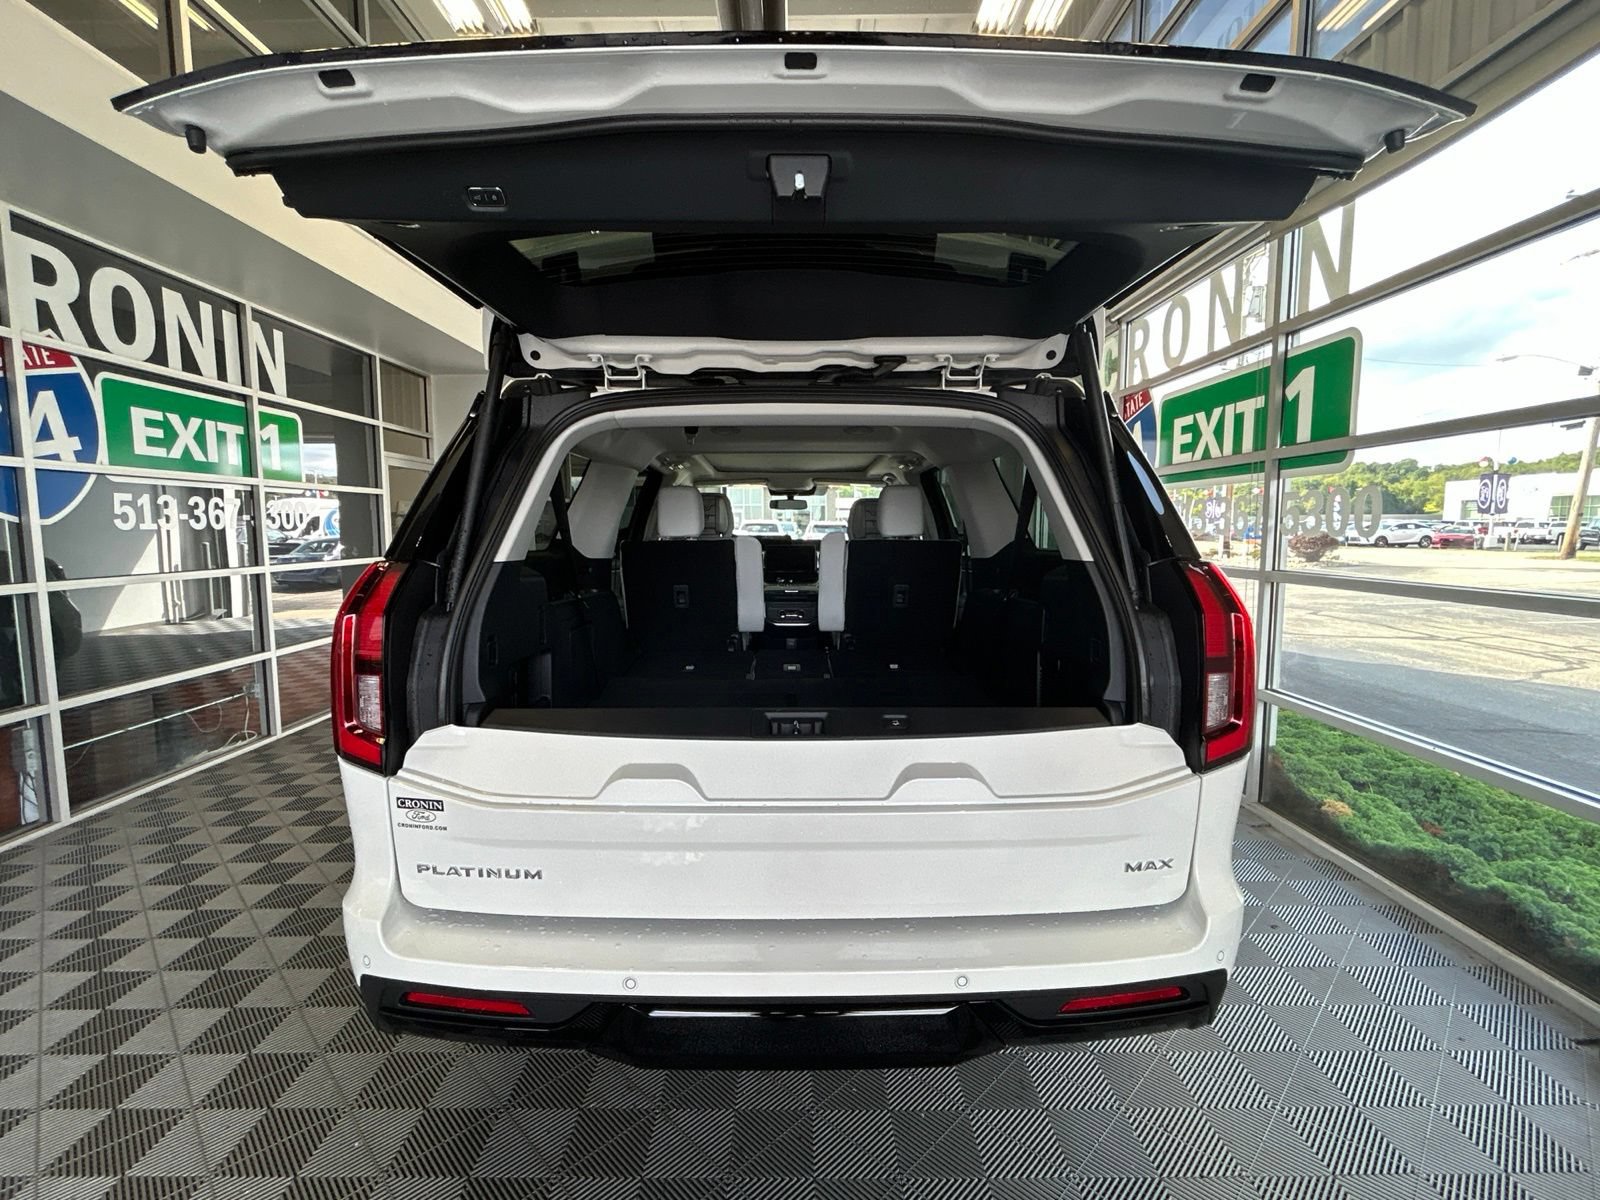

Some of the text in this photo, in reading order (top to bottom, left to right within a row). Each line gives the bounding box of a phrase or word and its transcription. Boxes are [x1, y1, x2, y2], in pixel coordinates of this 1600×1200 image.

[1172, 365, 1316, 465] EXIT 1
[130, 406, 282, 471] EXIT 1
[113, 492, 308, 531] 513-367-300
[397, 798, 443, 811] CRONIN
[397, 822, 448, 831] CRONINFORD.COM
[416, 863, 543, 880] PLATINUM
[1124, 858, 1174, 873] MAX
